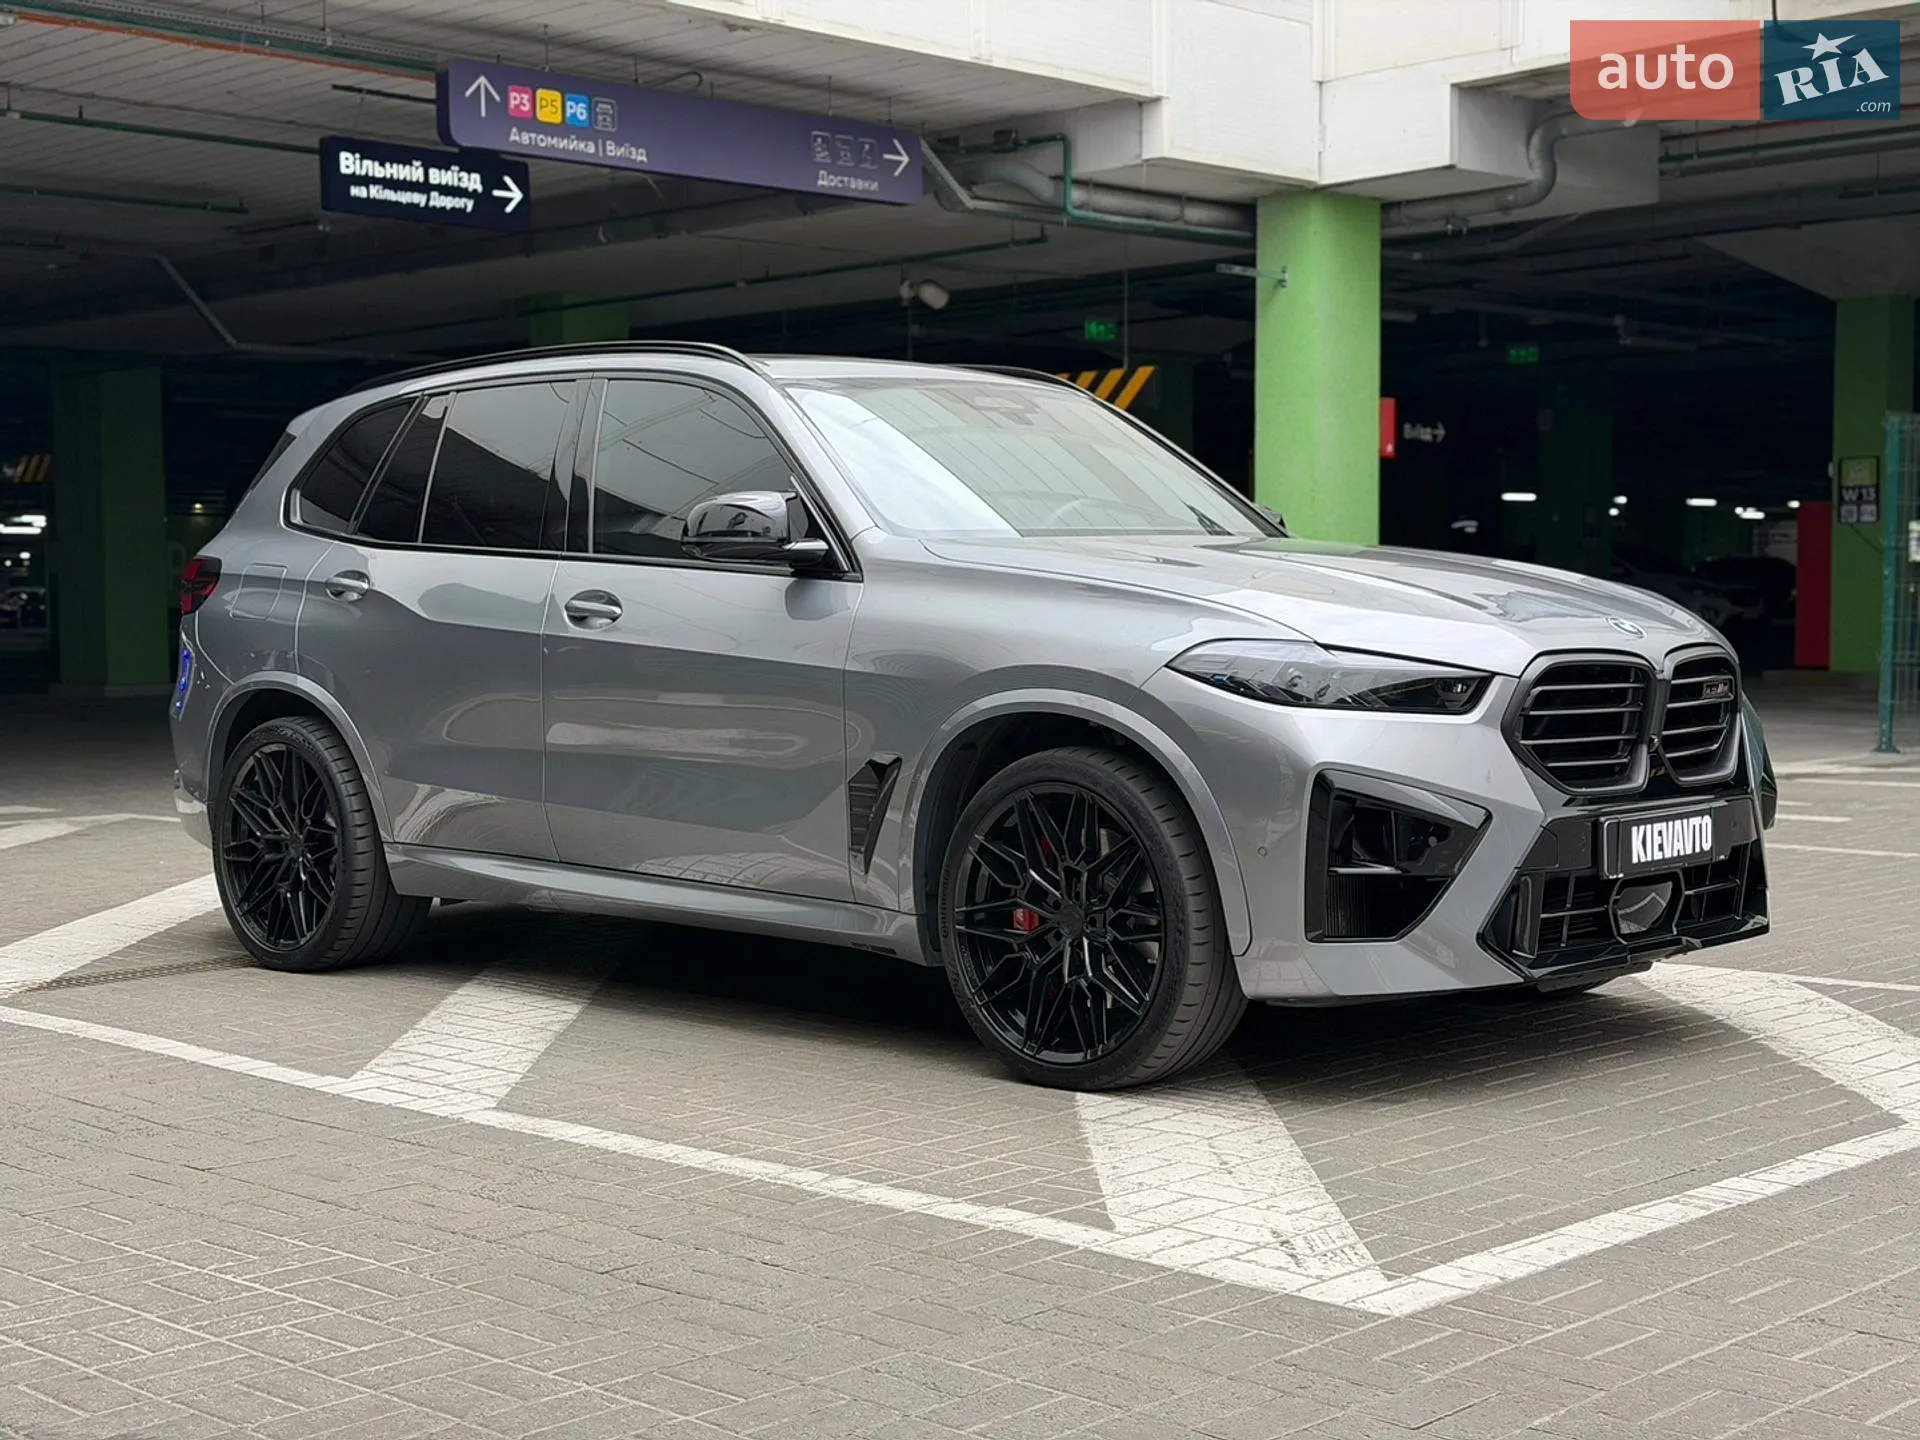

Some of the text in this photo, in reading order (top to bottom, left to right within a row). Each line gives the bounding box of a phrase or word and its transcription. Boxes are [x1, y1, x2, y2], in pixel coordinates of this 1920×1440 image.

[510, 92, 587, 120] P3 P5 P6
[509, 127, 647, 163] Автомийка Виїзд
[339, 151, 483, 193] Вільний виїзд
[817, 169, 879, 191] Доставки
[350, 186, 368, 198] на
[428, 191, 475, 213] Дорогу
[1632, 815, 1712, 864] KIEVAVTO
